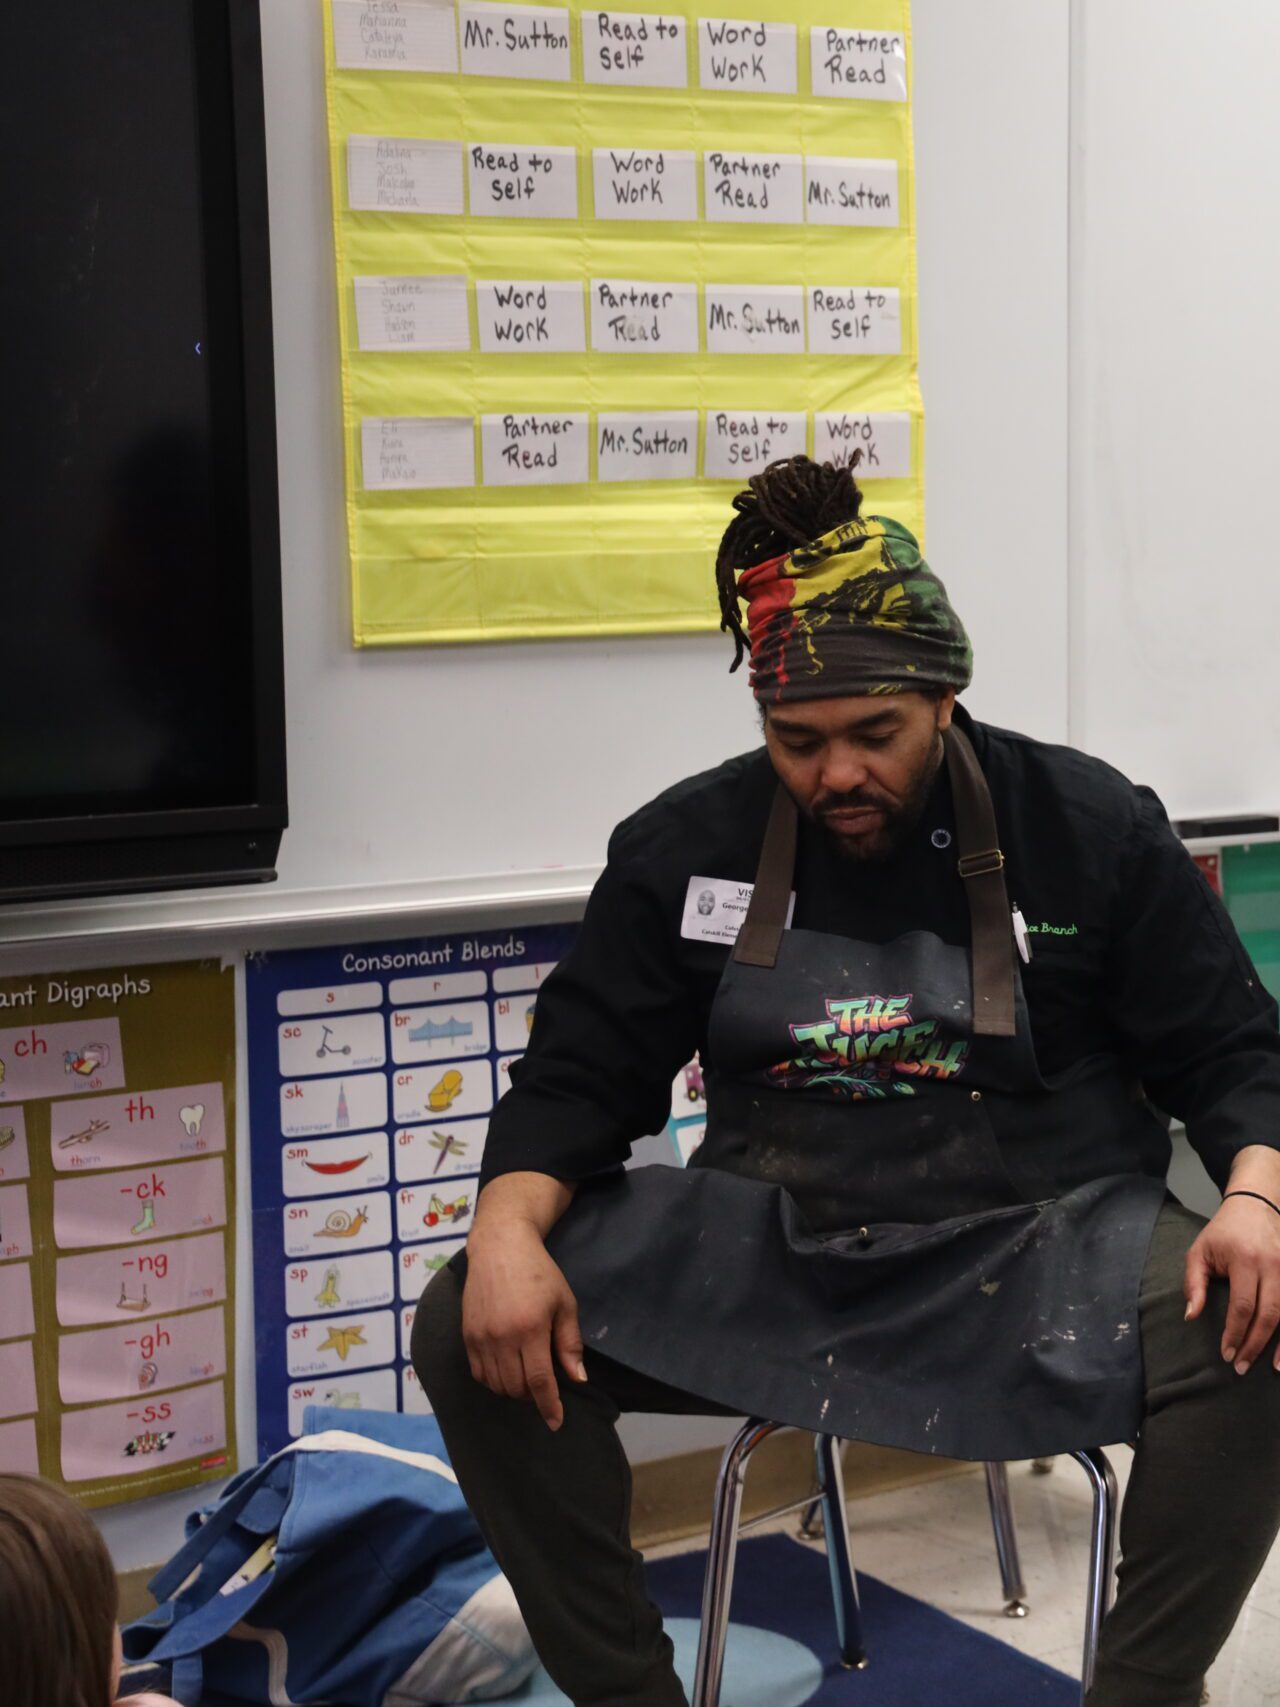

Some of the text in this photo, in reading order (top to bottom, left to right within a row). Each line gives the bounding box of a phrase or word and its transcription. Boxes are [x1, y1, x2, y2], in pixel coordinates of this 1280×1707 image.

[464, 17, 567, 51] Mr. Sutton
[599, 13, 678, 41] Read to
[706, 22, 766, 47] Word
[825, 28, 899, 54] Partner
[824, 57, 885, 84] Read
[471, 146, 552, 173] Read to
[610, 151, 664, 174] Word
[709, 152, 780, 178] Partner
[714, 180, 768, 209] Read
[807, 180, 890, 208] Mr. Sutton
[494, 285, 546, 310] Word
[597, 284, 672, 309] Partner
[812, 289, 885, 311] Read to
[607, 314, 660, 341] Read
[708, 302, 800, 334] Mr. Sutton
[502, 414, 573, 437] Partner
[715, 412, 787, 436] Read to
[826, 418, 872, 439] Word
[600, 426, 687, 455] Mr. Sutton
[501, 442, 557, 469] Read
[1041, 922, 1078, 934] Branch
[342, 935, 526, 974] Consonant Blends
[47, 974, 151, 1008] Digraphs
[326, 992, 335, 1004] s
[498, 1001, 511, 1015] bl
[828, 996, 911, 1033] THE
[283, 1026, 302, 1039] sc
[394, 1013, 411, 1028] br
[14, 1030, 47, 1057] ch
[285, 1084, 304, 1099] sk
[397, 1073, 413, 1086] cr
[124, 1096, 155, 1122] th
[398, 1131, 414, 1145] dr
[286, 1146, 308, 1159] sm
[120, 1173, 166, 1199] -ck
[401, 1191, 414, 1205] fr
[289, 1208, 308, 1219] sn
[122, 1254, 168, 1278] -ng
[403, 1253, 419, 1267] gr
[290, 1268, 308, 1283] sp
[124, 1323, 171, 1360] -gh
[291, 1324, 308, 1340] st
[292, 1387, 315, 1399] sw
[126, 1402, 172, 1423] -ss
